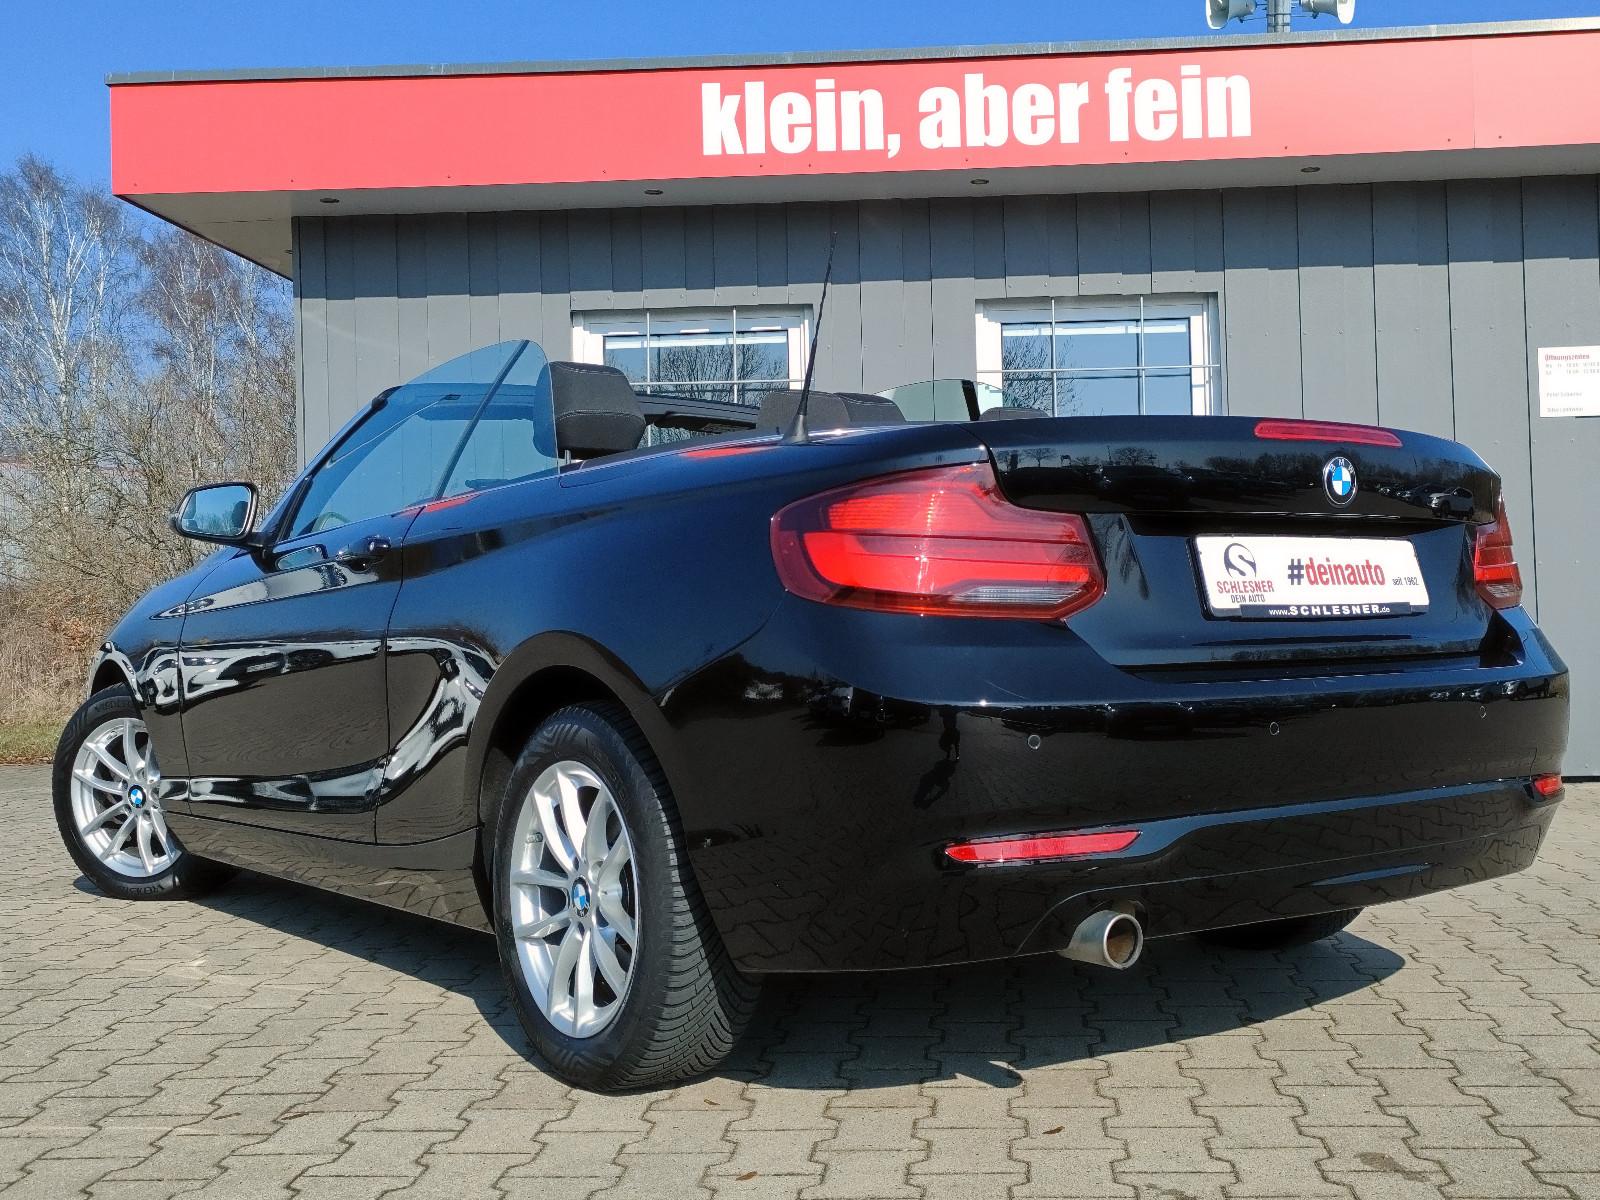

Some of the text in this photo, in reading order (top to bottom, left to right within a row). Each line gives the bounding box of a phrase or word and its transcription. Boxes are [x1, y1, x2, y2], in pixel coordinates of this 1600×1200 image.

[701, 64, 1252, 158] klein, aber fein
[1287, 557, 1386, 586] #deinauto
[1216, 580, 1275, 594] SCHLESNER
[1392, 576, 1420, 586] seit 1962
[1231, 594, 1266, 604] DEIN AUTO
[1269, 604, 1391, 616] www.SCHLESNER.de
